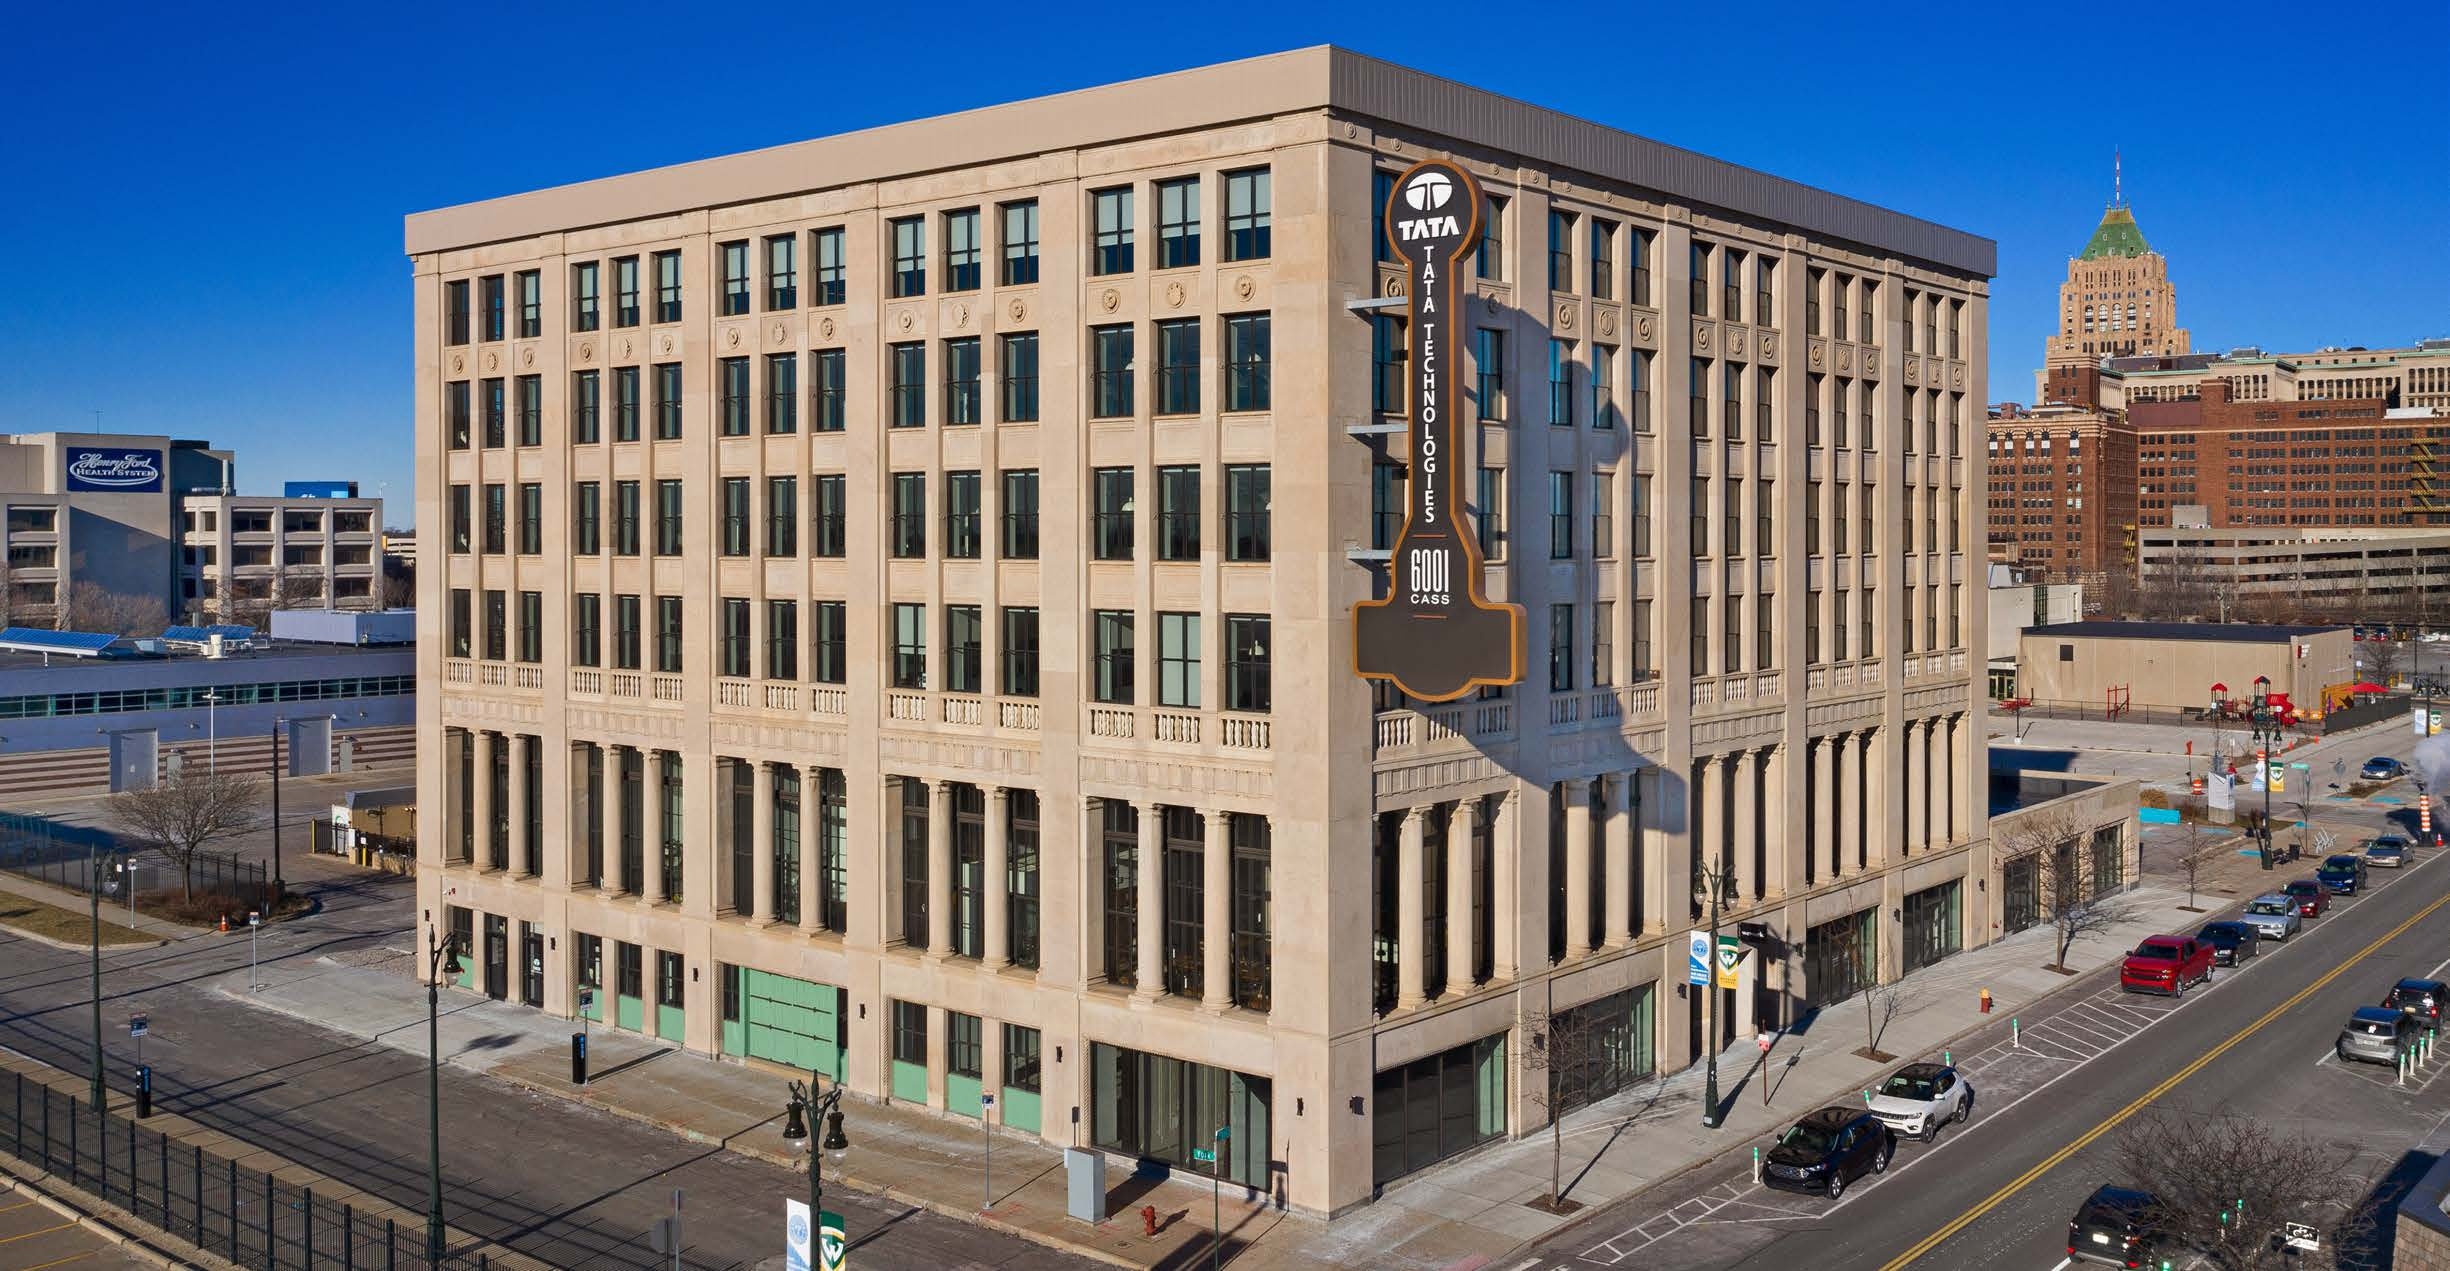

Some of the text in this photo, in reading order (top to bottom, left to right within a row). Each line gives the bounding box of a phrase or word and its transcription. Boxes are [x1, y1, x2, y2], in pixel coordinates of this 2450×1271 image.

[1398, 215, 1460, 241] TATA
[1422, 245, 1436, 524] TATA TECHNOLOGIES
[79, 453, 152, 471] Henry Ford
[1411, 549, 1449, 592] 6001
[1410, 594, 1450, 605] CASS
